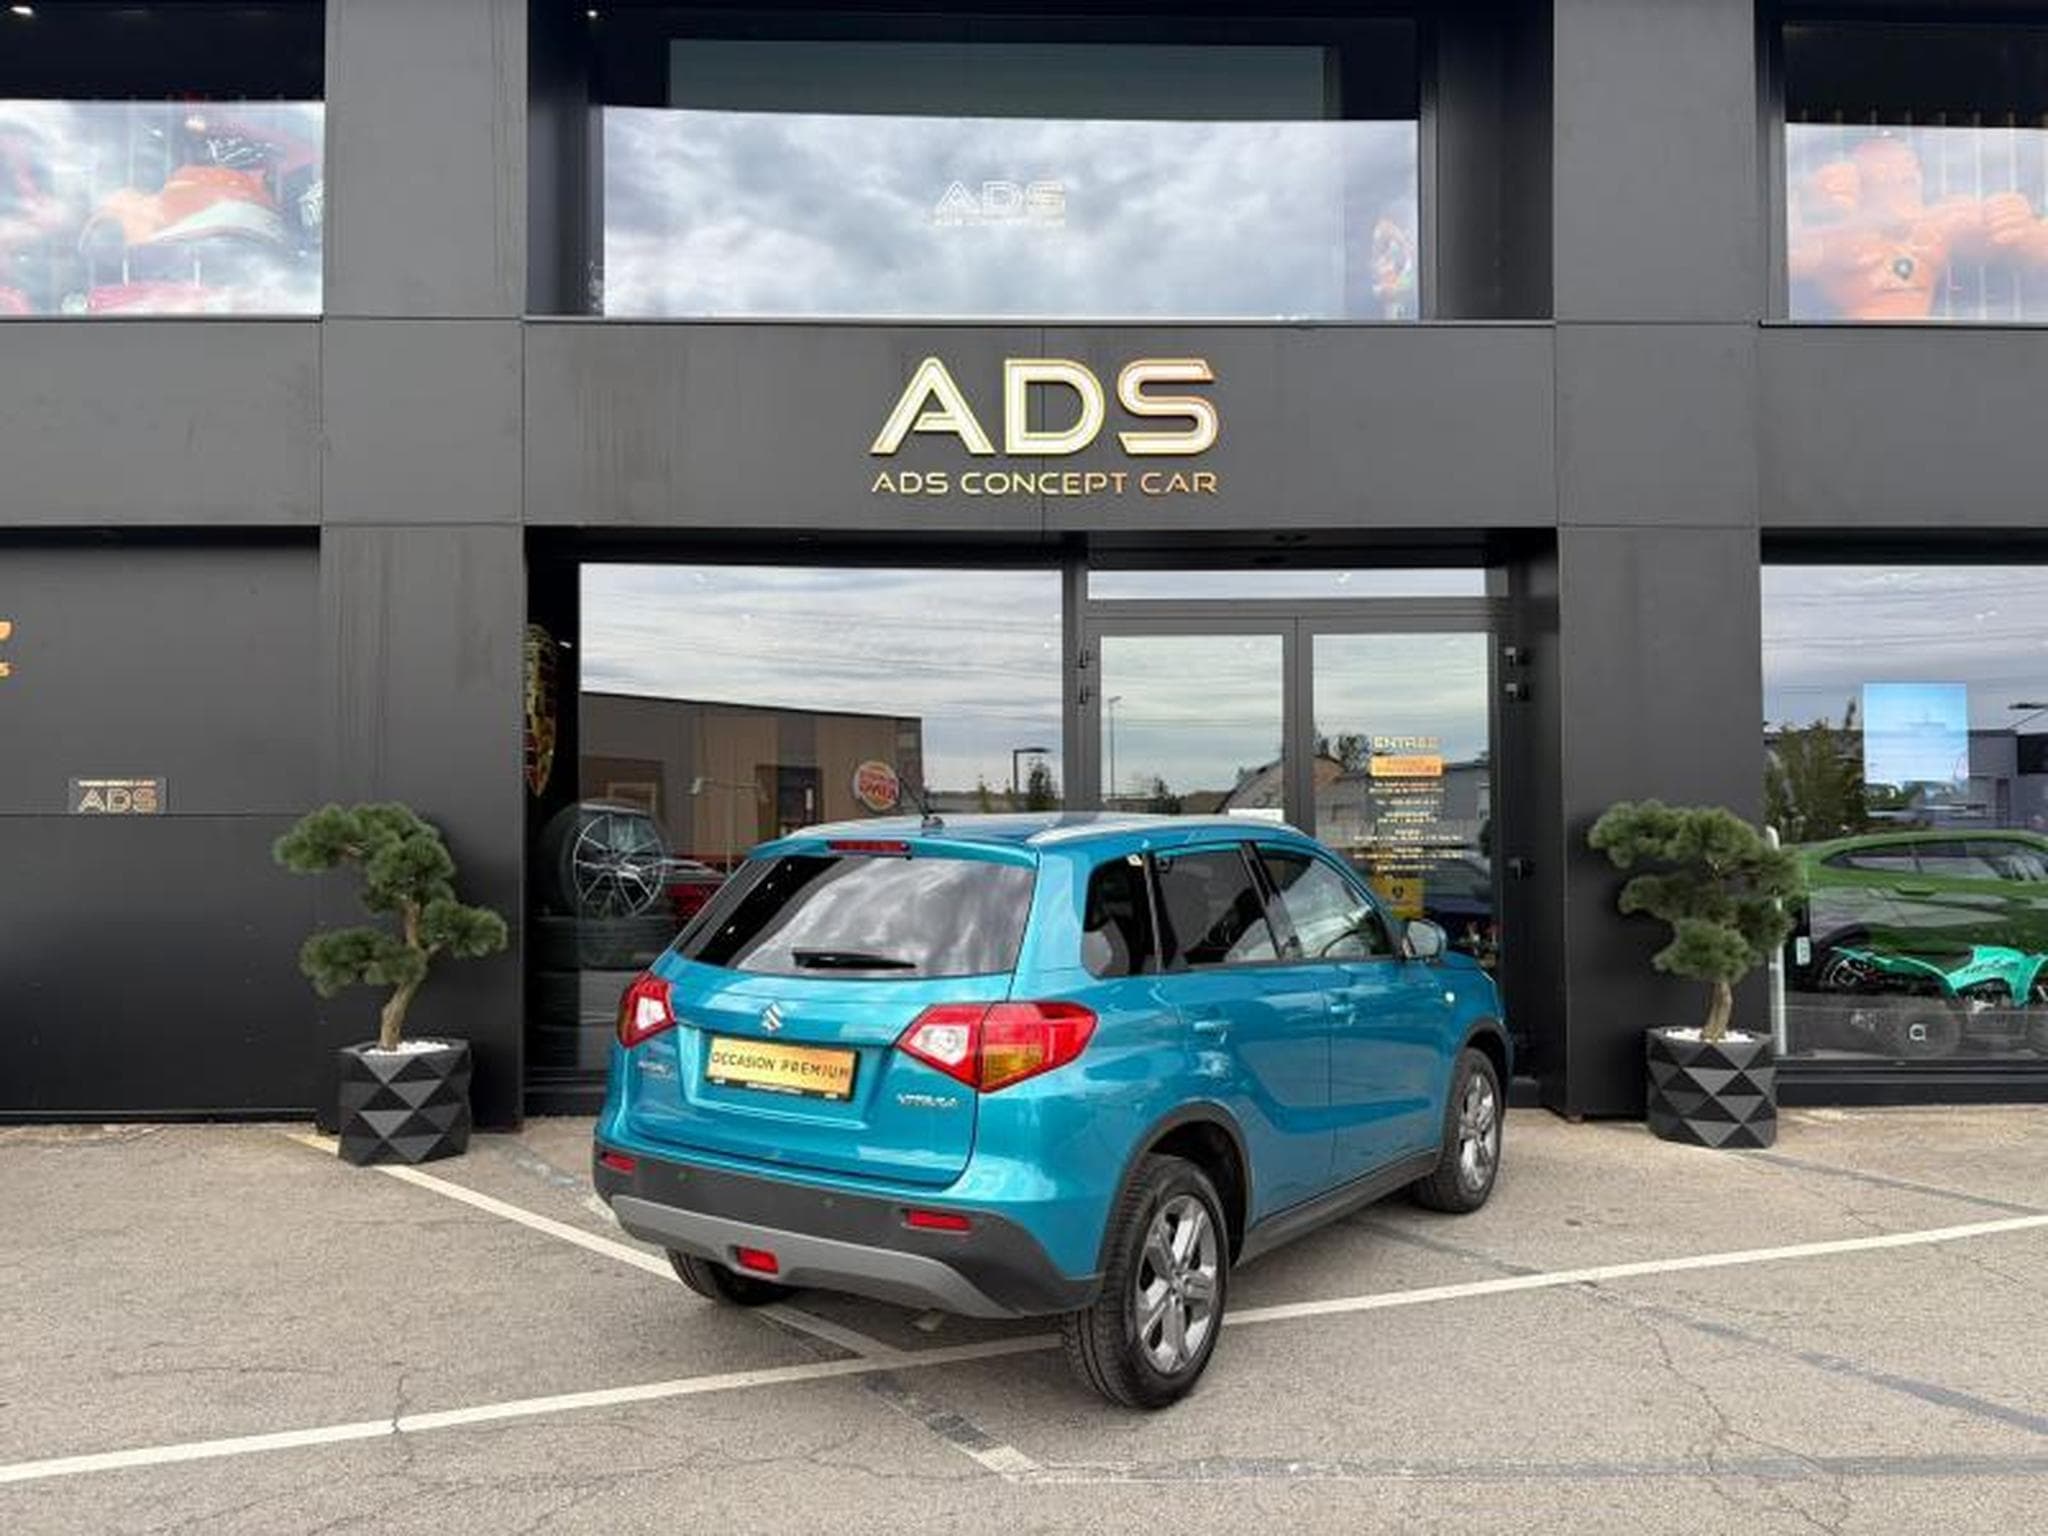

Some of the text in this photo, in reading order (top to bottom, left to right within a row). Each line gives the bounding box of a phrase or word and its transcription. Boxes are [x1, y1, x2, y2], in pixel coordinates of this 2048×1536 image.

[932, 179, 1066, 218] ADS
[869, 356, 1219, 456] ADS
[871, 472, 1218, 495] ADS CONCEPT CAR
[78, 787, 158, 812] ADS
[711, 1051, 850, 1080] OCCASION PREMIUM
